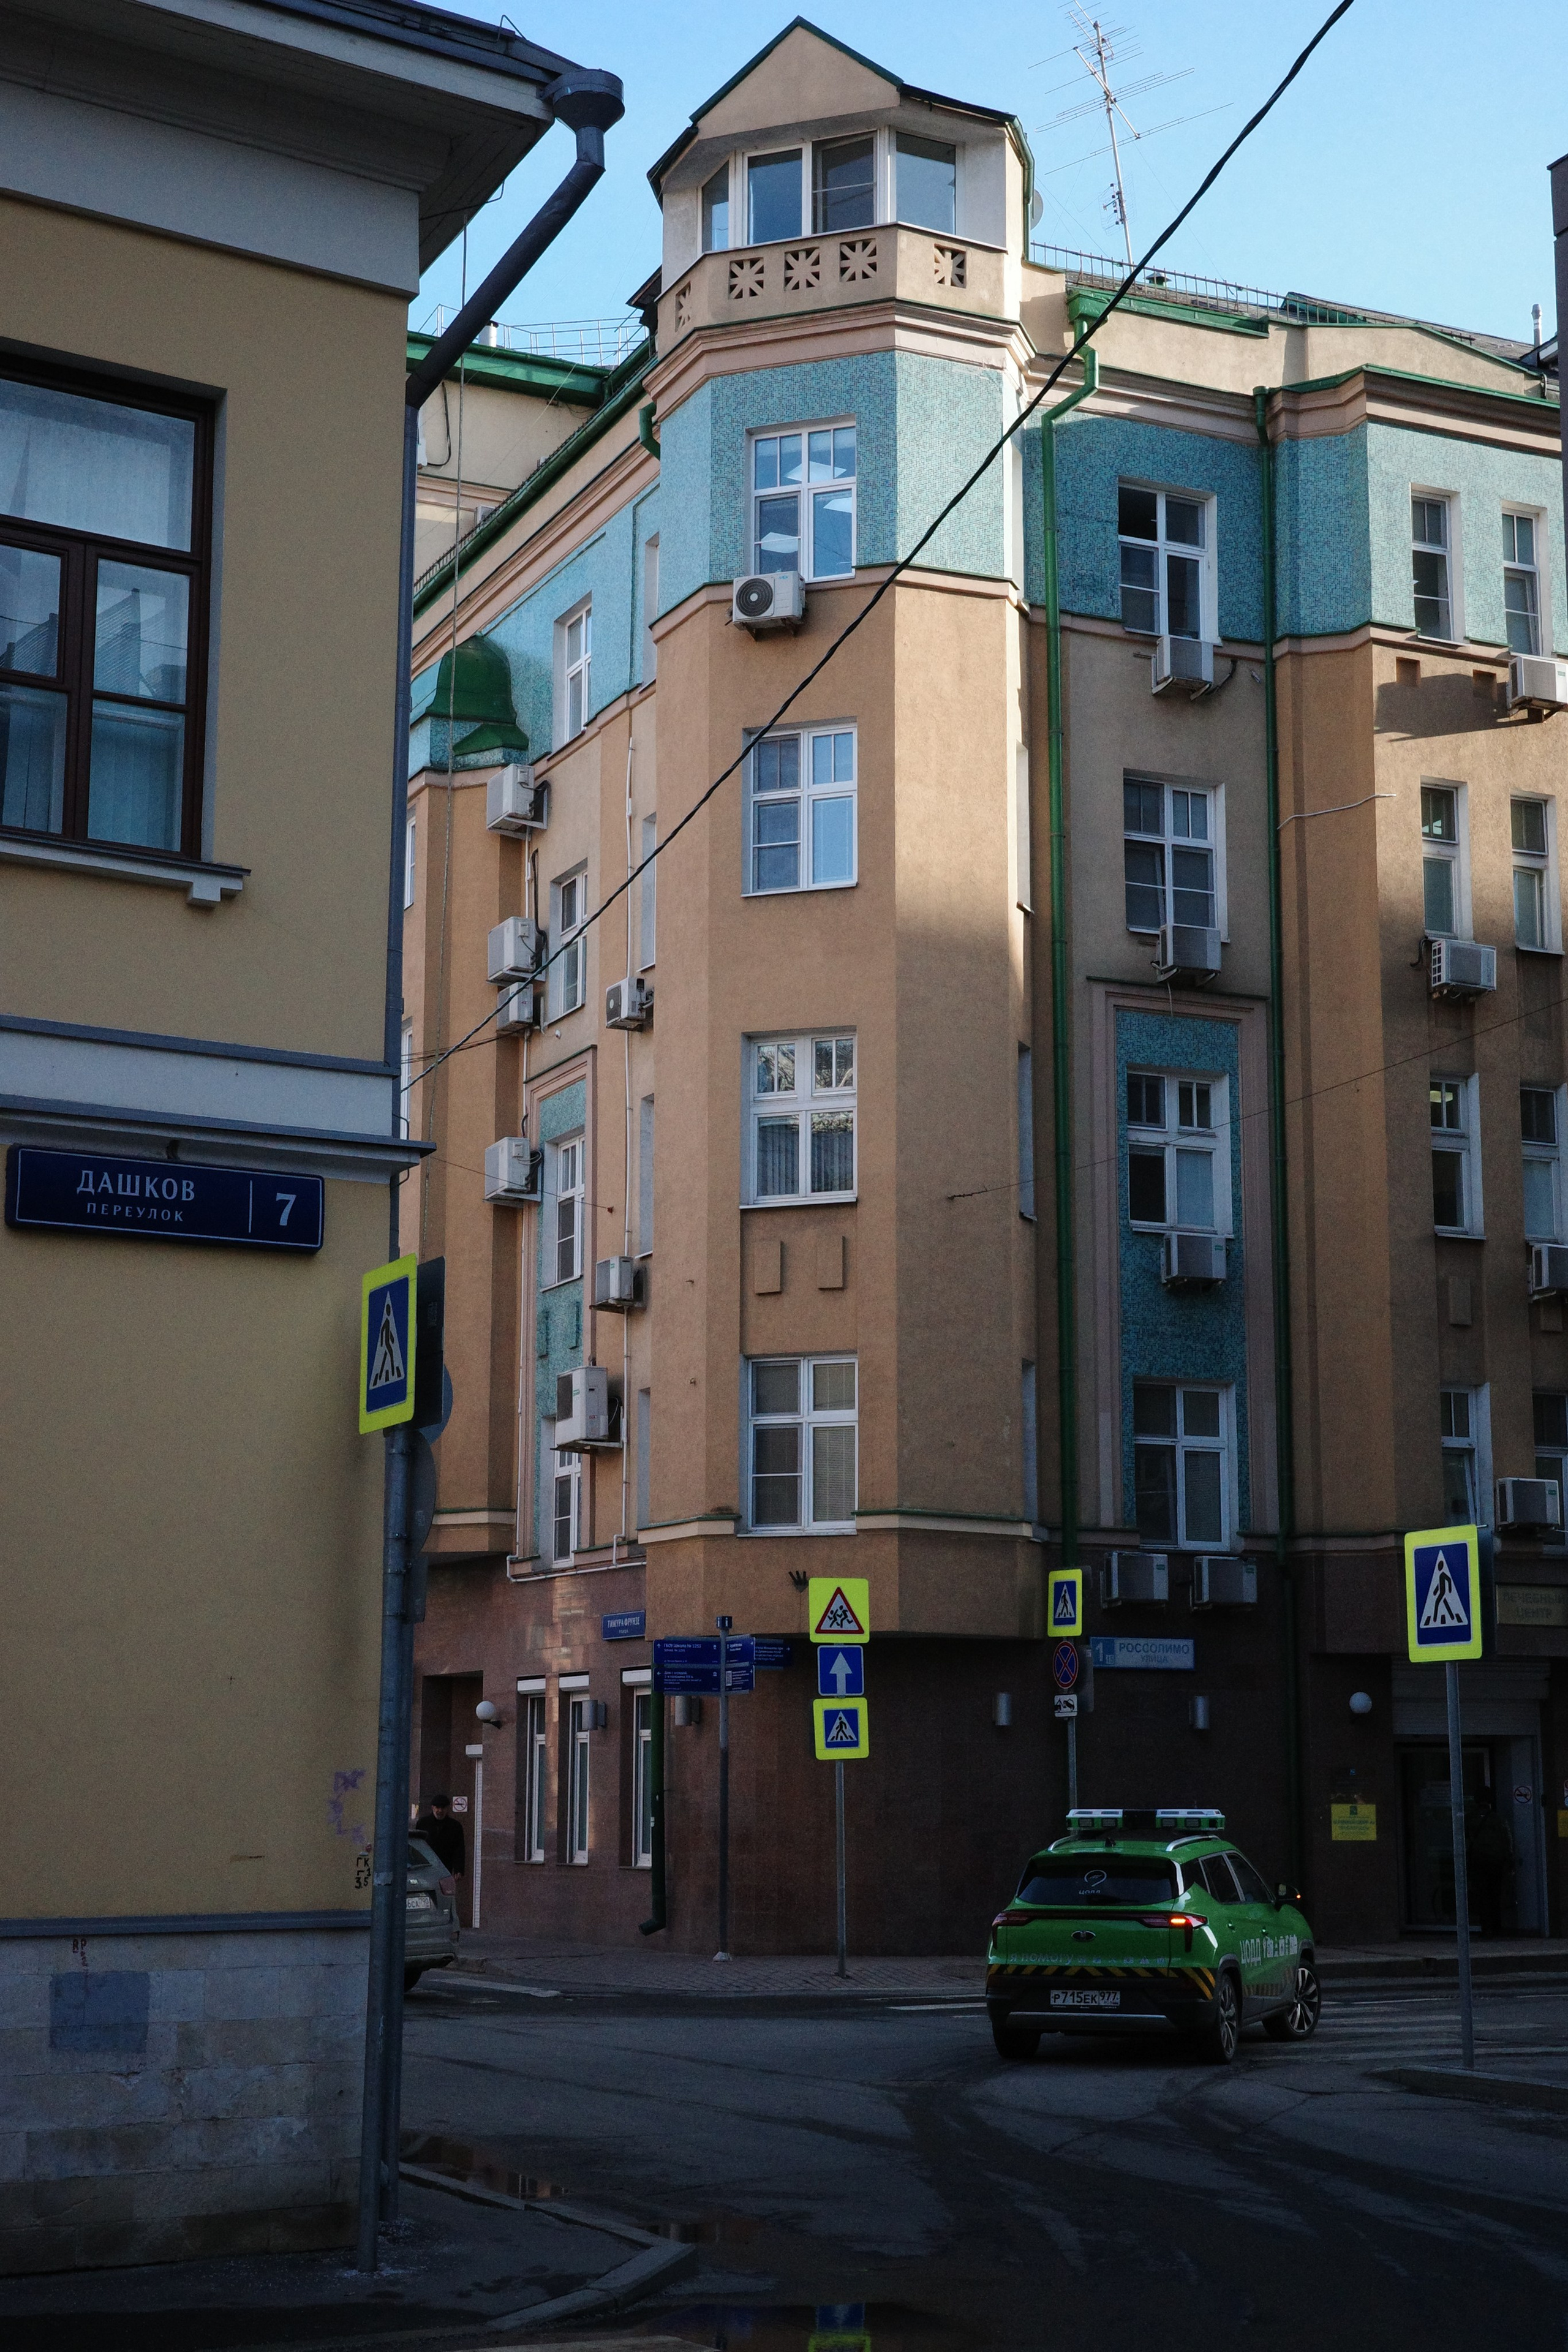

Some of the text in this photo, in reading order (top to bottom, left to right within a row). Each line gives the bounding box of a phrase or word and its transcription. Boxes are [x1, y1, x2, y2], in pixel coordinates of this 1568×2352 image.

[77, 1170, 195, 1201] ДАШКОВ
[87, 1202, 184, 1222] ПЕРЕУЛОК
[276, 1193, 297, 1226] 7
[1118, 1642, 1190, 1654] РОССОЛИМО
[1140, 1655, 1169, 1664] УЛИЦА
[1239, 1938, 1262, 1968] ЦОДД
[1099, 1991, 1117, 2001] 977
